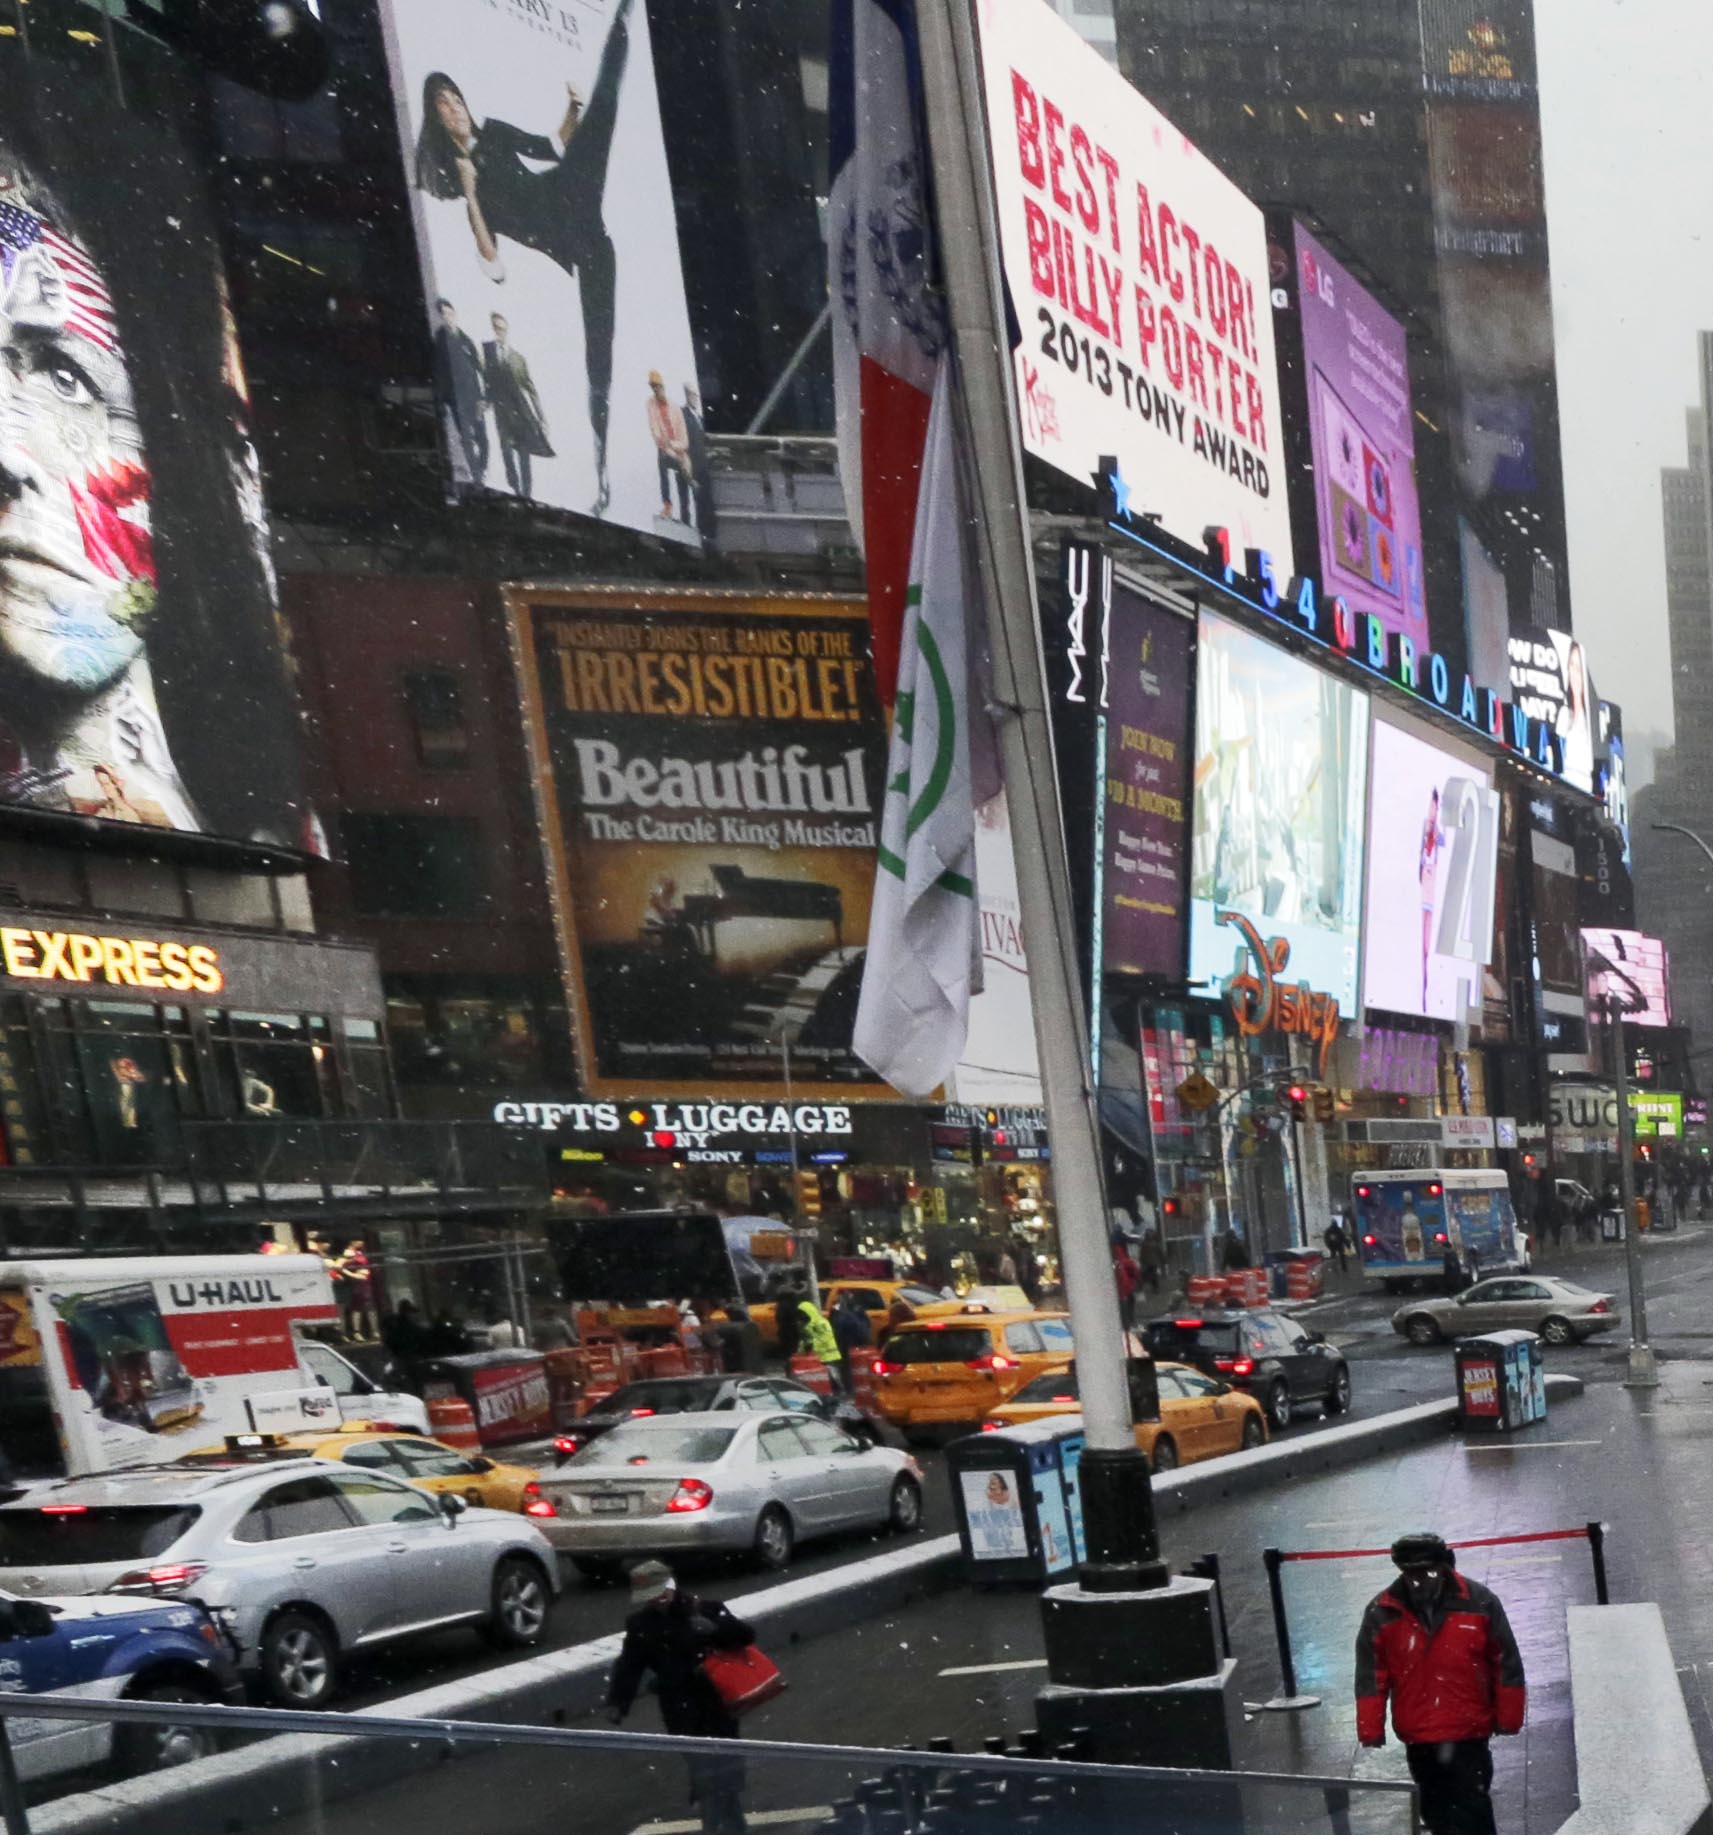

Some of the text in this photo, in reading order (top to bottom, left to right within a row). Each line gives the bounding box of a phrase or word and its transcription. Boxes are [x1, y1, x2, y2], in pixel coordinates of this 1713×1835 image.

[1009, 65, 1259, 366] BEST ACTOR!
[1023, 194, 1122, 348] BILLY
[1135, 281, 1268, 454] PORTER
[1036, 306, 1113, 396] 2013
[1117, 362, 1186, 445] TONY
[1193, 420, 1270, 499] AWARD
[798, 630, 821, 656] OF
[822, 632, 850, 657] THE
[1366, 612, 1568, 775] BROADWAY
[573, 738, 873, 813] Beautiful
[584, 812, 877, 850] The Carole King Musical
[0, 928, 224, 994] EXPRESS
[494, 1102, 853, 1134] GIFTS LUGGAGE
[687, 1150, 743, 1163] SONY
[168, 1279, 283, 1308] U-HAUL
